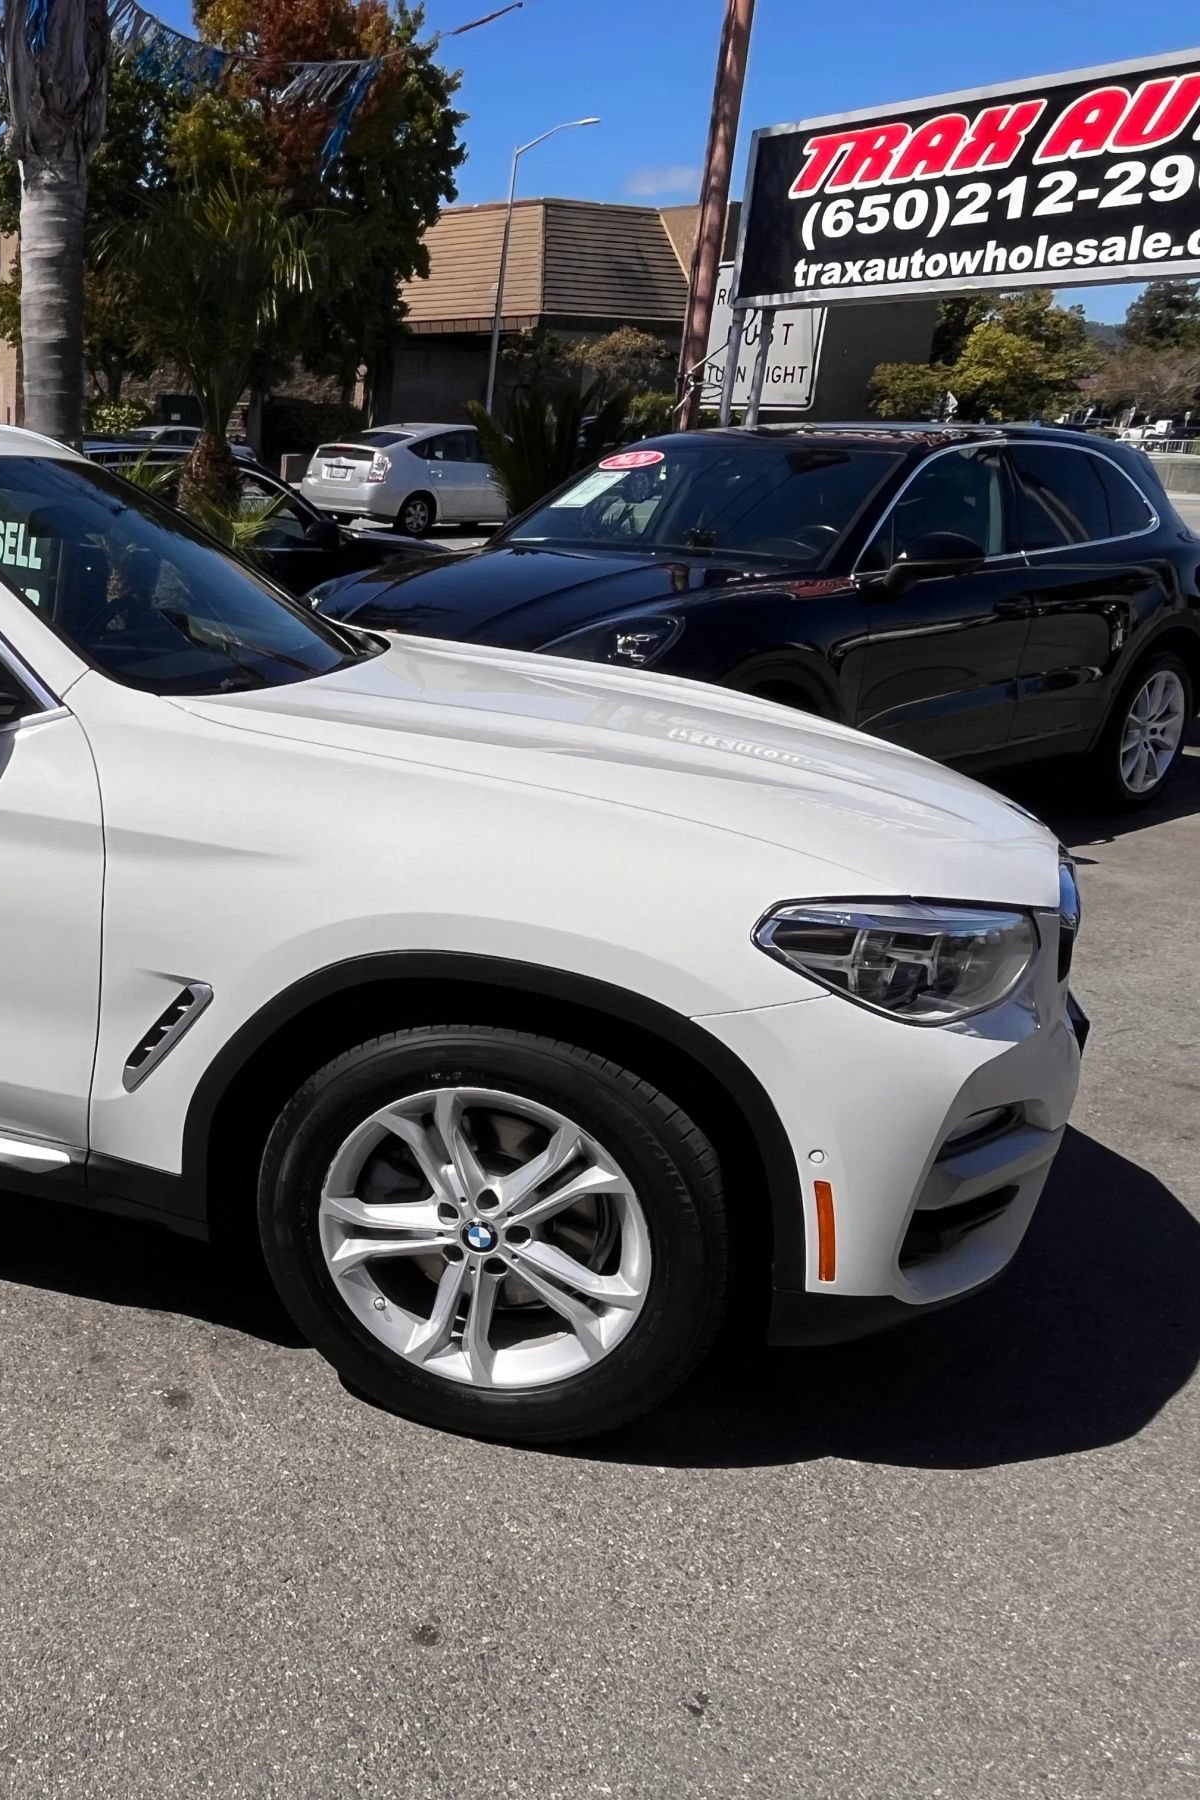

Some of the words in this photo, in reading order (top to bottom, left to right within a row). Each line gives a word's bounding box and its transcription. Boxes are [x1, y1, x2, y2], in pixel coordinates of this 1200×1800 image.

[788, 98, 1048, 200] TRAX
[1032, 72, 1200, 165] AU
[801, 153, 1200, 251] (650)212-29
[707, 365, 746, 383] TUN
[765, 365, 808, 384] IGHT
